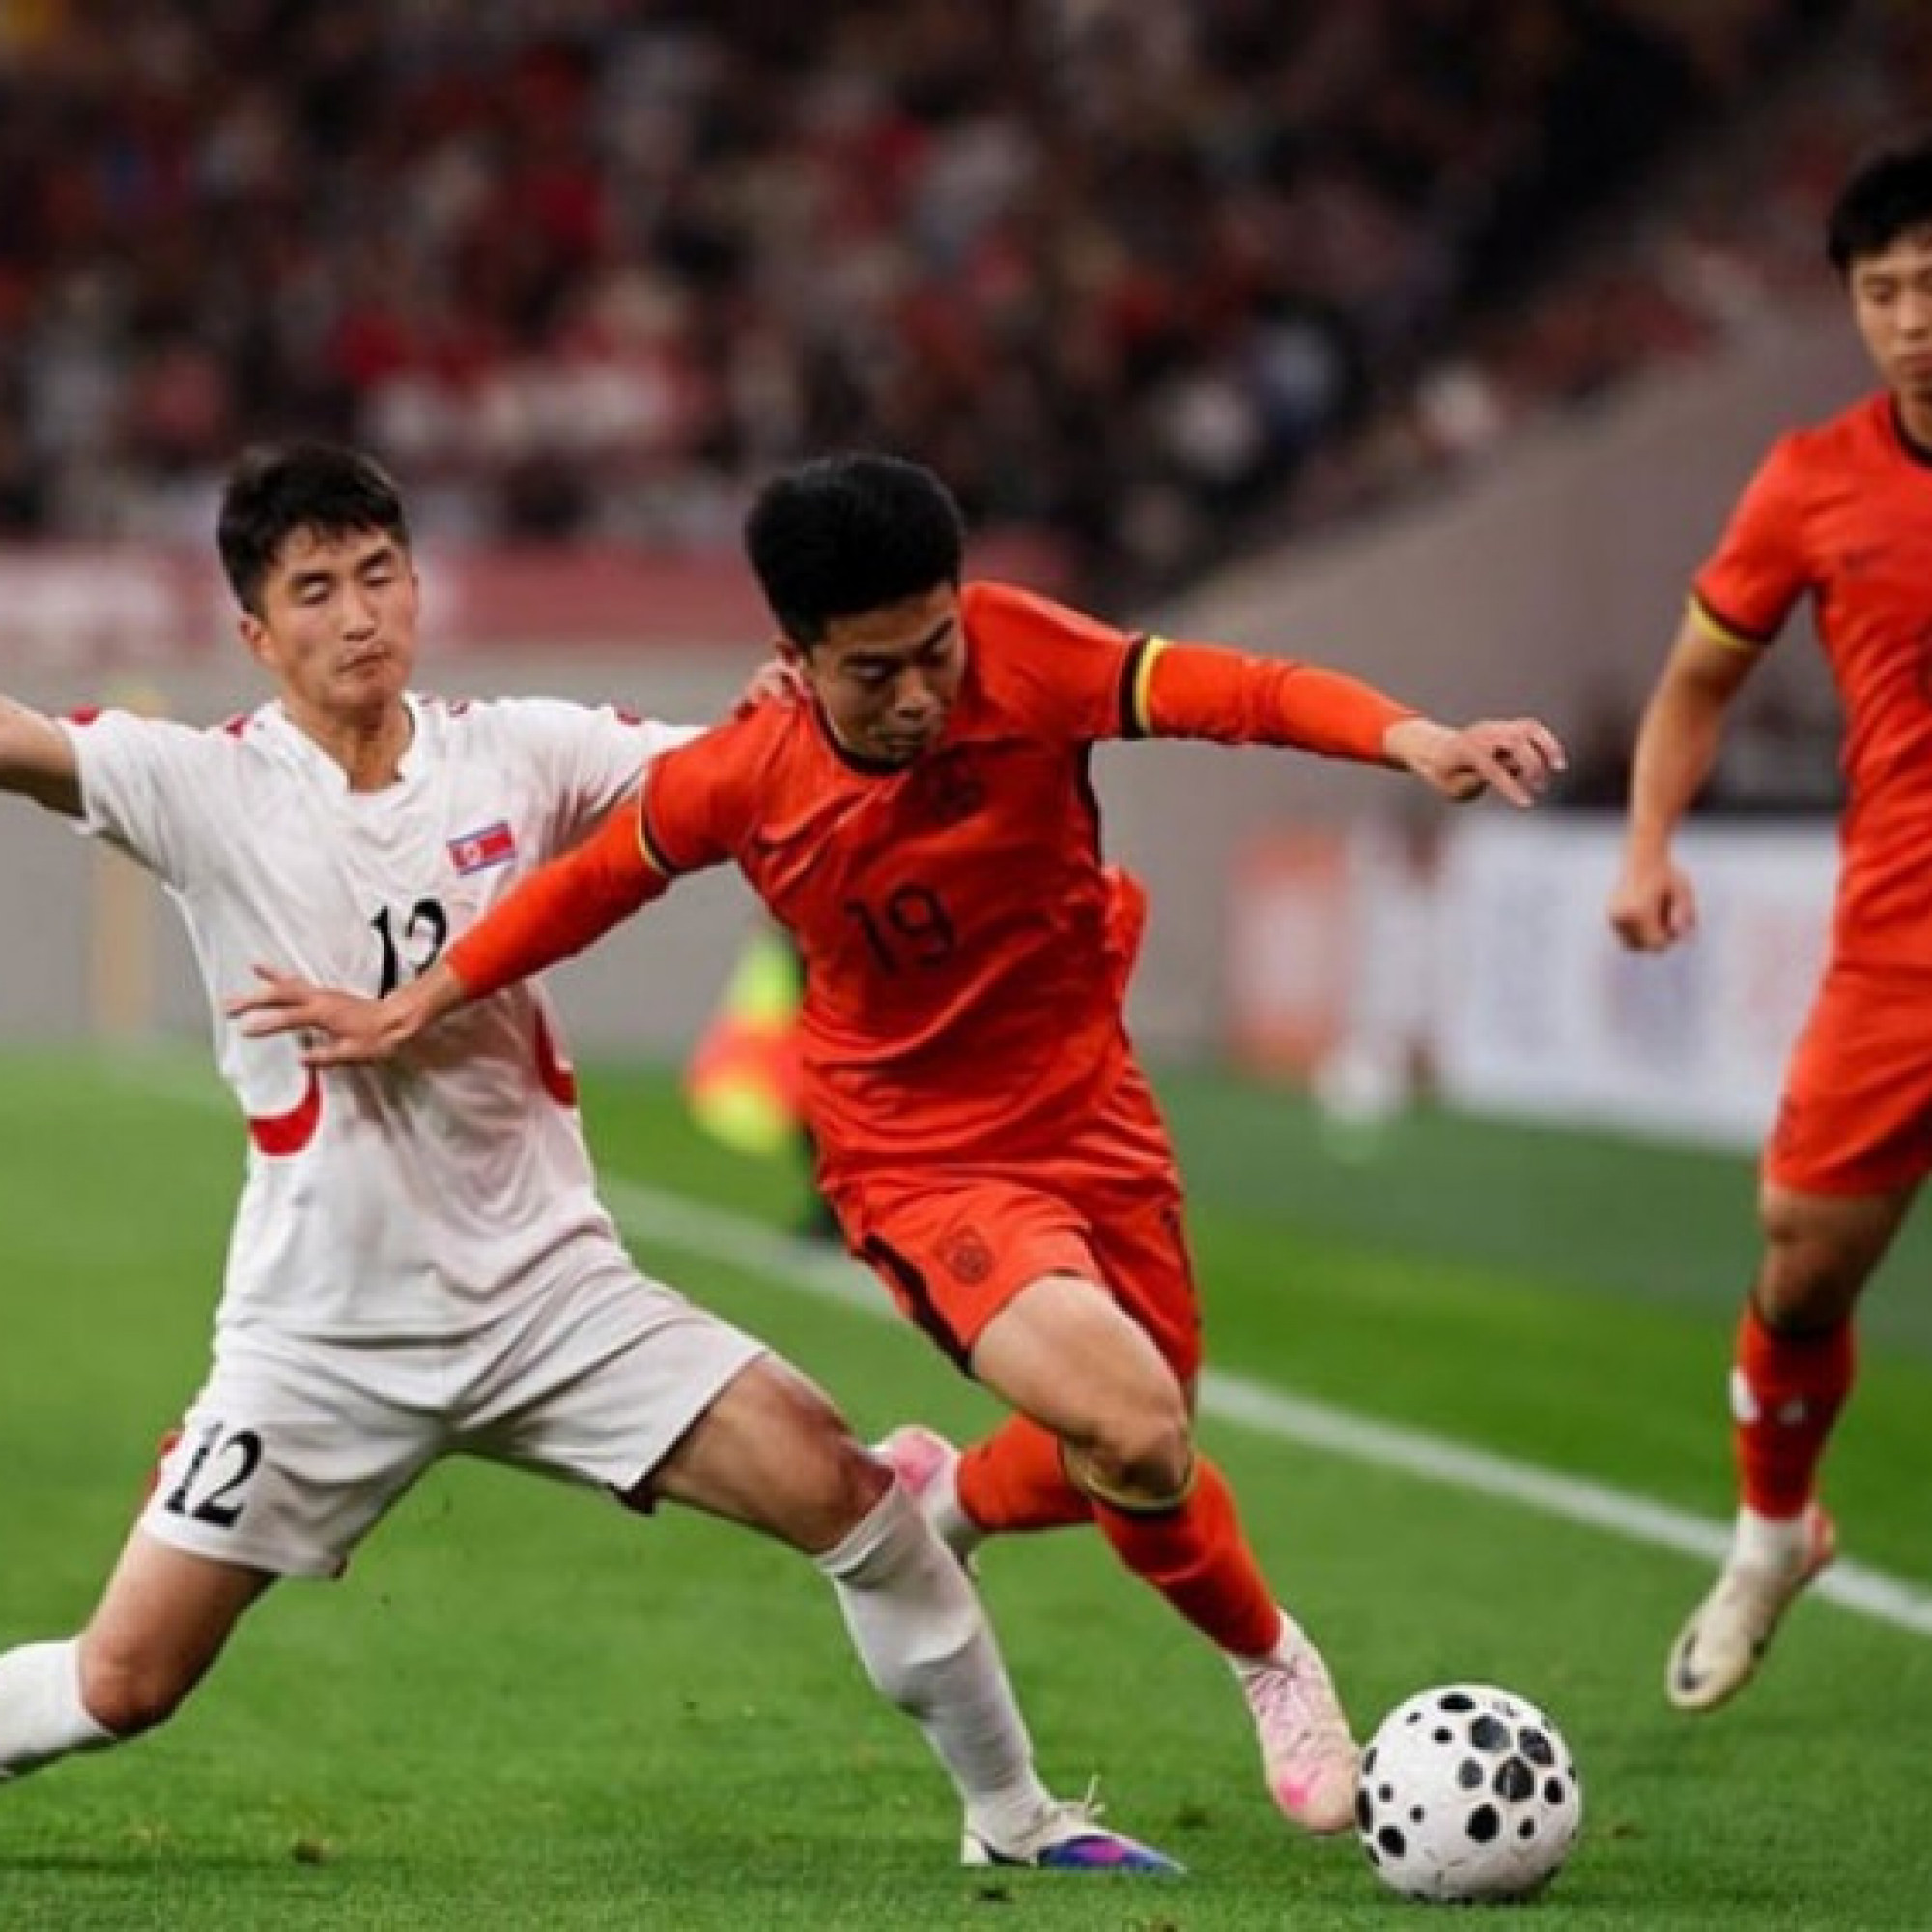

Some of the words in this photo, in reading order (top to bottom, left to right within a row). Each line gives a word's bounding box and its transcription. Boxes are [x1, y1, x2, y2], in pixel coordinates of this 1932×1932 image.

[370, 897, 447, 1000] 12
[843, 883, 955, 974] 19
[163, 1420, 263, 1530] 12
